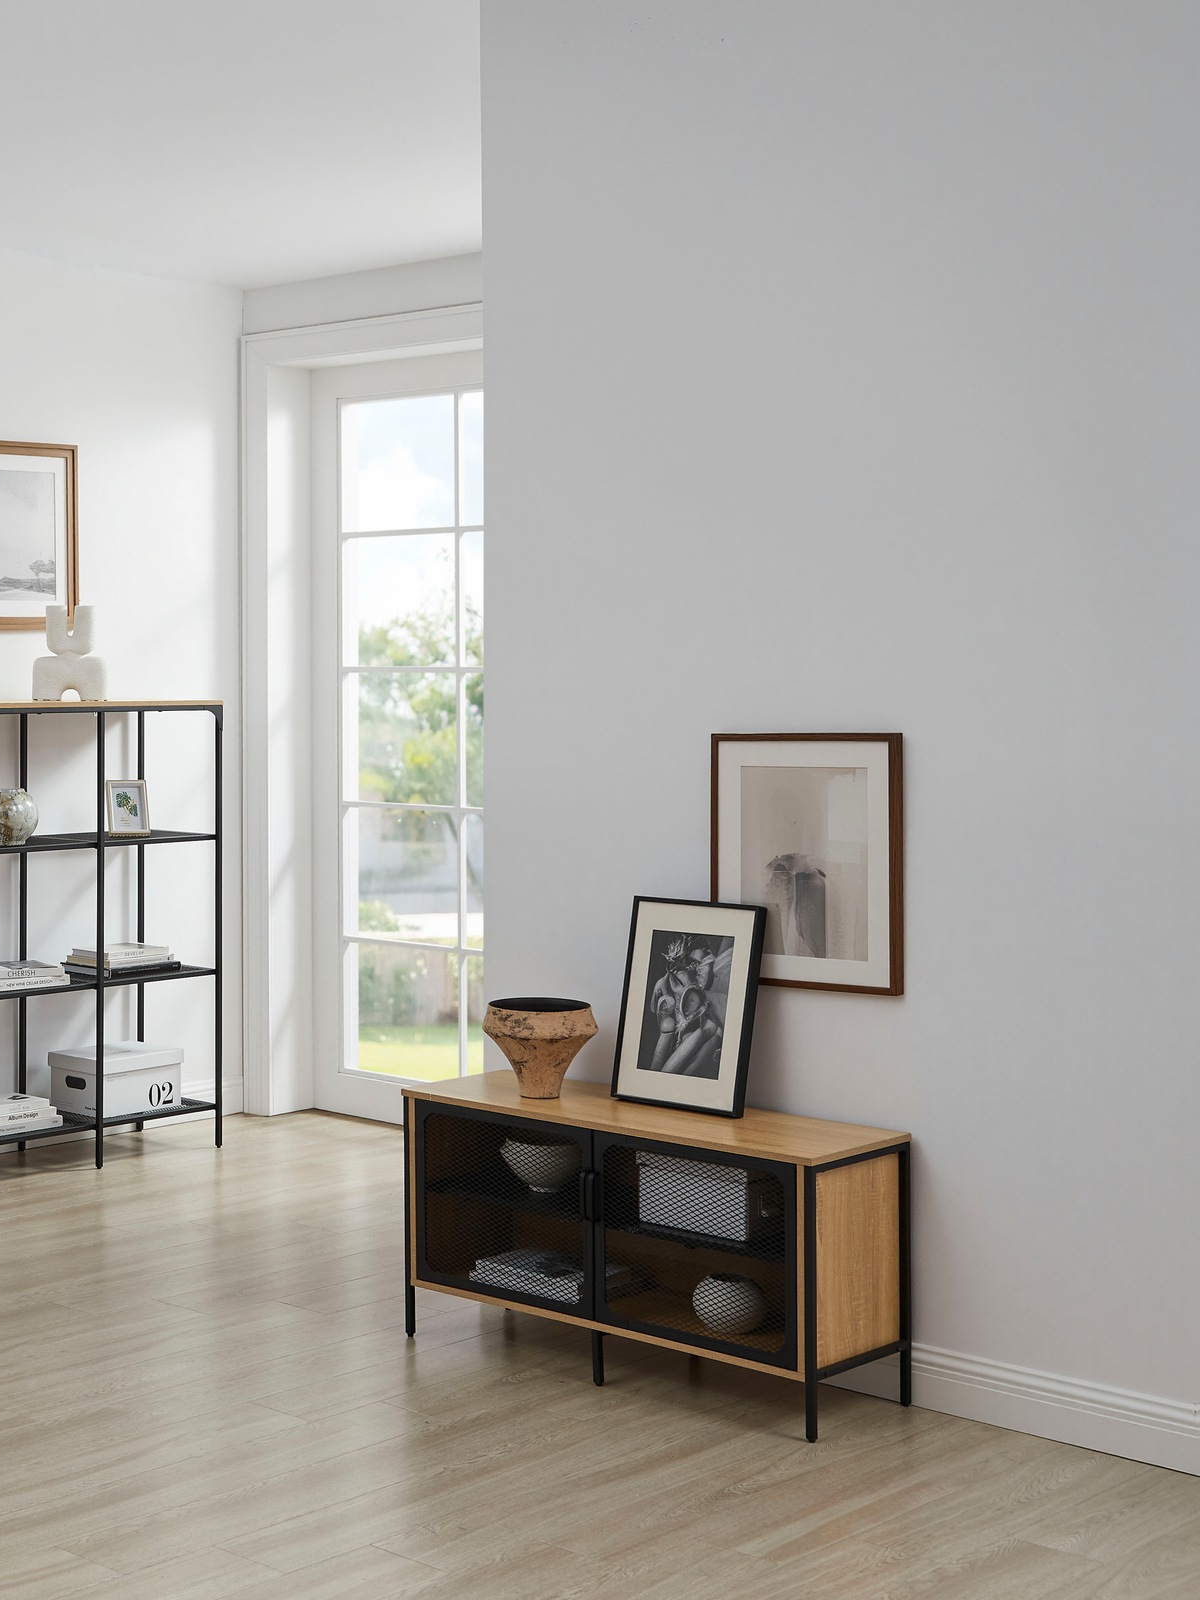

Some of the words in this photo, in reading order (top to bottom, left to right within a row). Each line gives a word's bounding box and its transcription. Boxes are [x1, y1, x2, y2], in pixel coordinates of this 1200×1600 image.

[7, 969, 36, 978] CHERISH
[148, 1081, 174, 1107] 02
[7, 1114, 23, 1122] Album
[23, 1111, 39, 1119] Design
